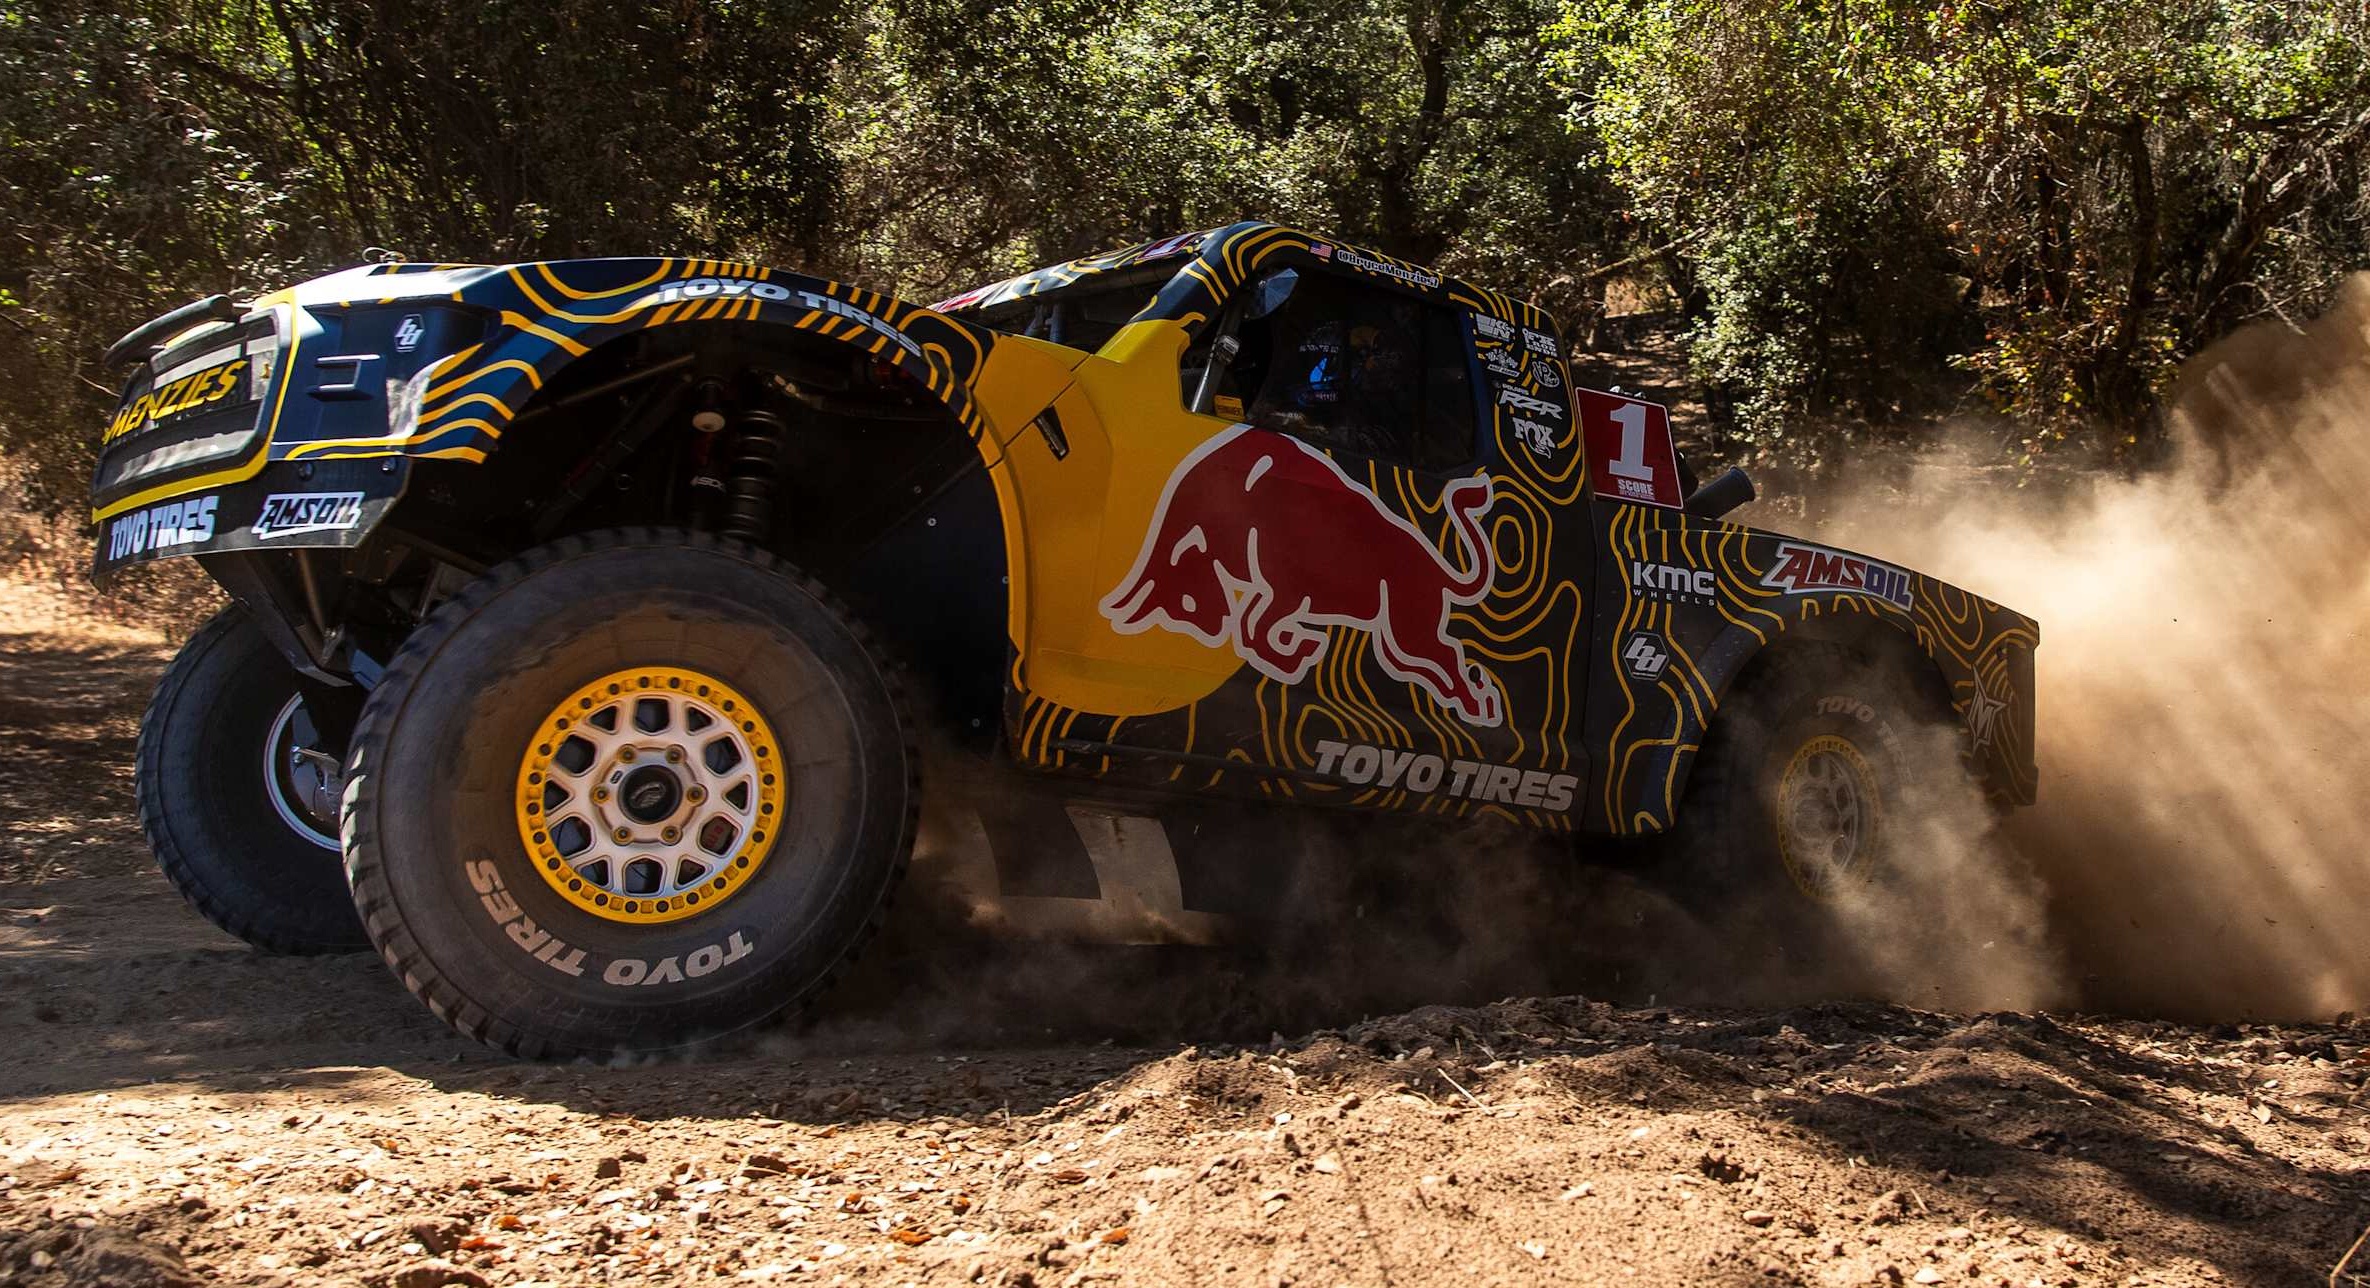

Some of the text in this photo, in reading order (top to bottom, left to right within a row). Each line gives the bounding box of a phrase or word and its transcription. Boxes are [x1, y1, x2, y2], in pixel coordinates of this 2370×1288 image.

[659, 278, 921, 357] TOYO TIRES
[102, 360, 248, 445] MENZIES
[1499, 390, 1562, 419] RZR
[1512, 417, 1556, 457] FOX
[1609, 403, 1653, 481] 1
[252, 491, 365, 540] AMSOIL
[1618, 479, 1654, 496] SCORE
[108, 495, 220, 561] TOYO TIRES
[1633, 588, 1715, 607] WHEELS
[1762, 542, 1914, 612] AMSOIL
[1816, 696, 1876, 722] TOYO
[1315, 740, 1579, 812] TOYO TIRES
[465, 859, 754, 986] TOYO TIRES
